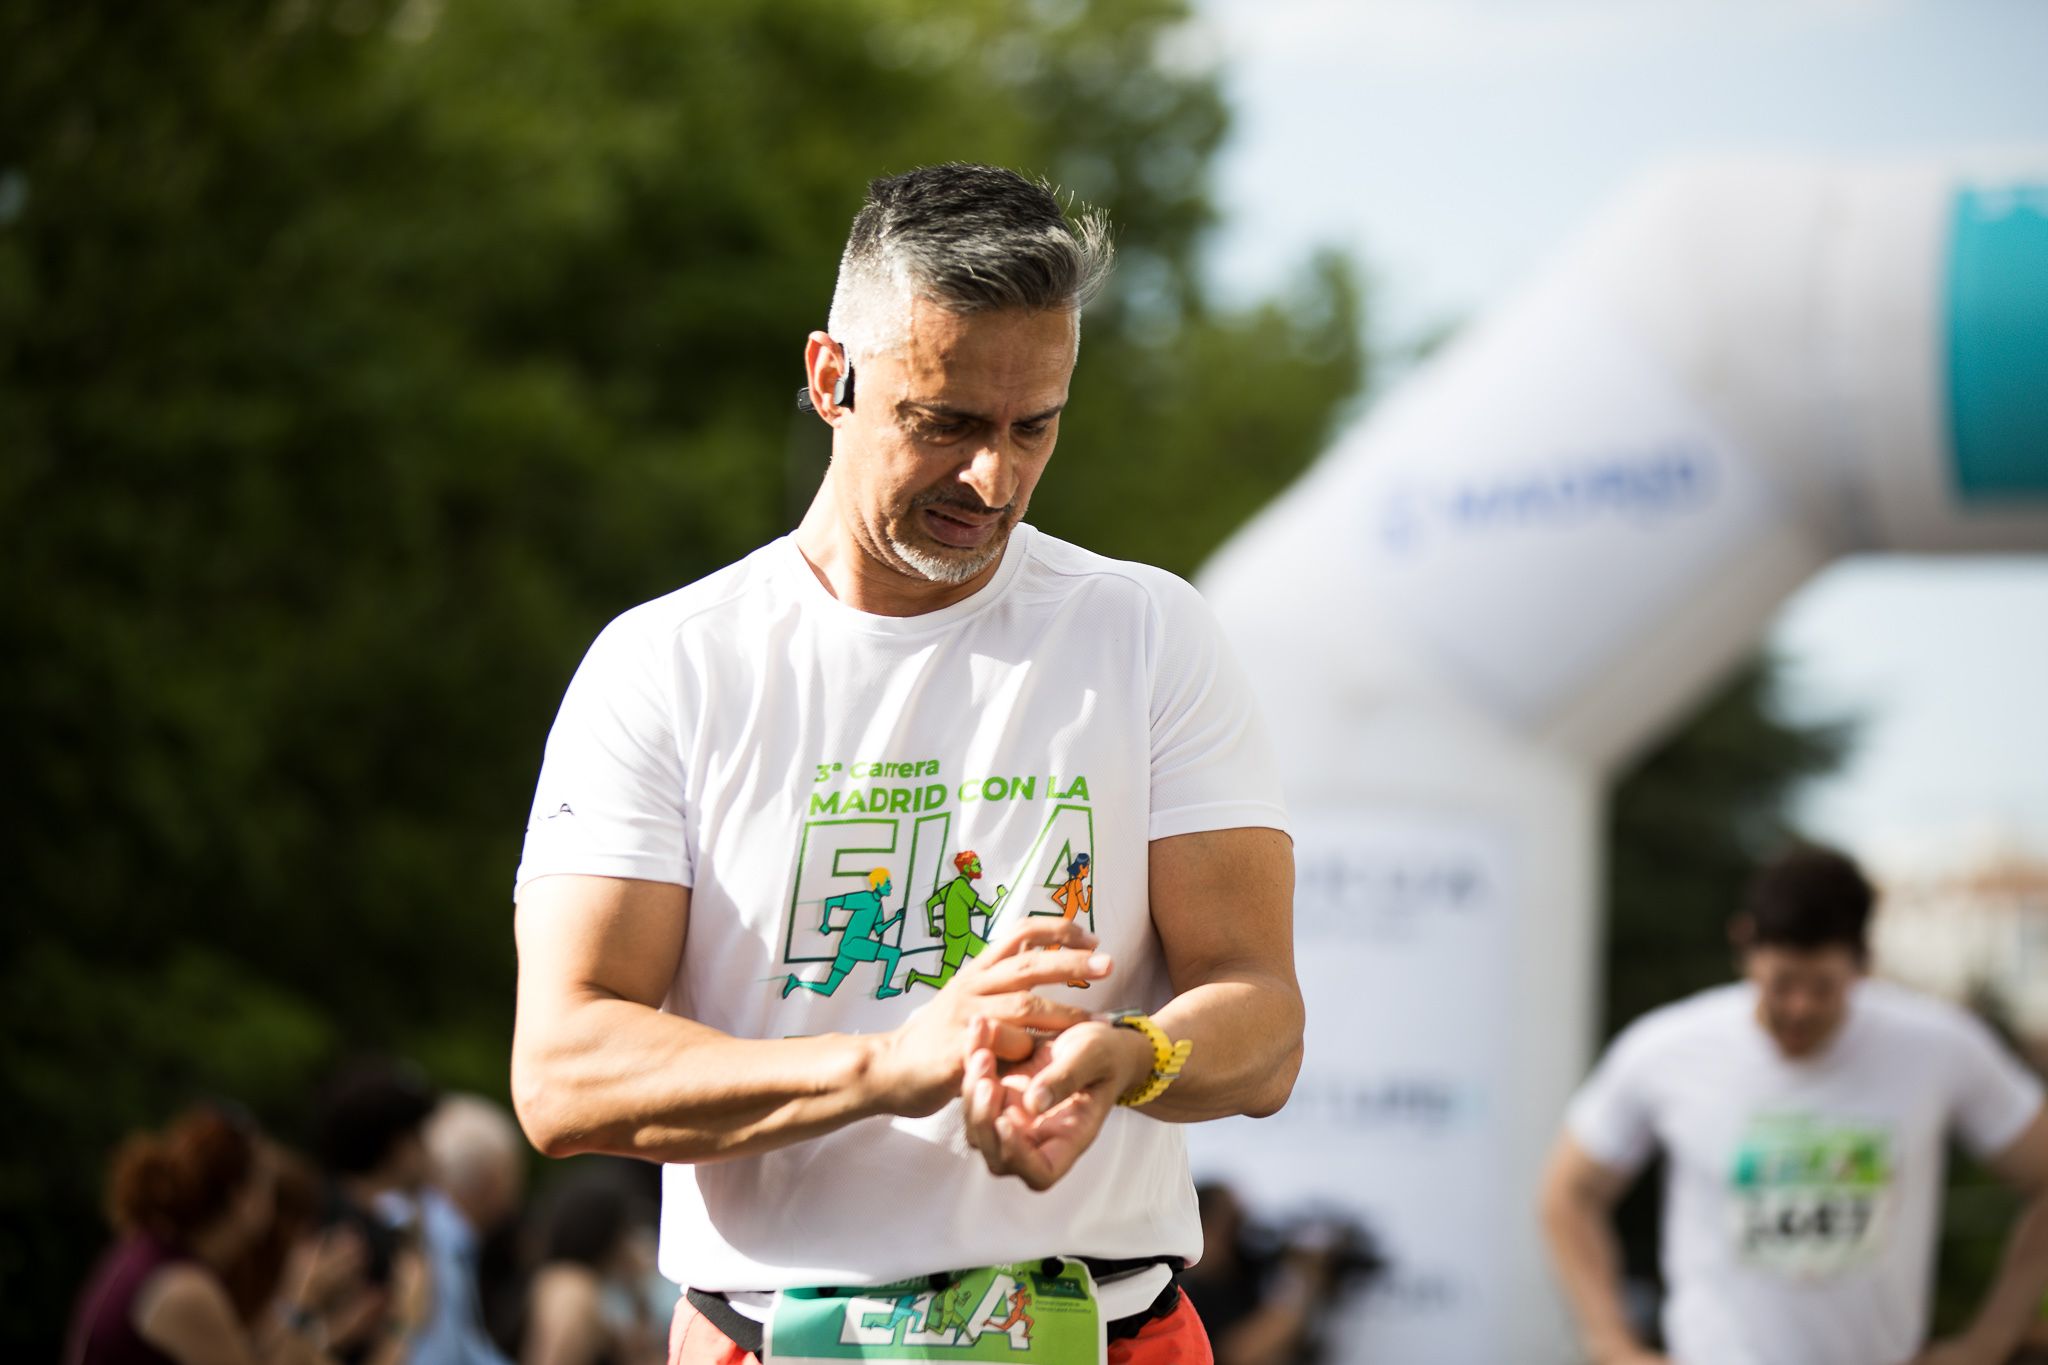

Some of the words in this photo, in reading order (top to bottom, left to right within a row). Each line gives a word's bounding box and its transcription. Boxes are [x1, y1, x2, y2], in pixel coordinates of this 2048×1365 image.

[849, 759, 940, 780] Carrera
[809, 784, 948, 816] MADRID
[957, 776, 1036, 803] CON
[1046, 775, 1090, 801] LA
